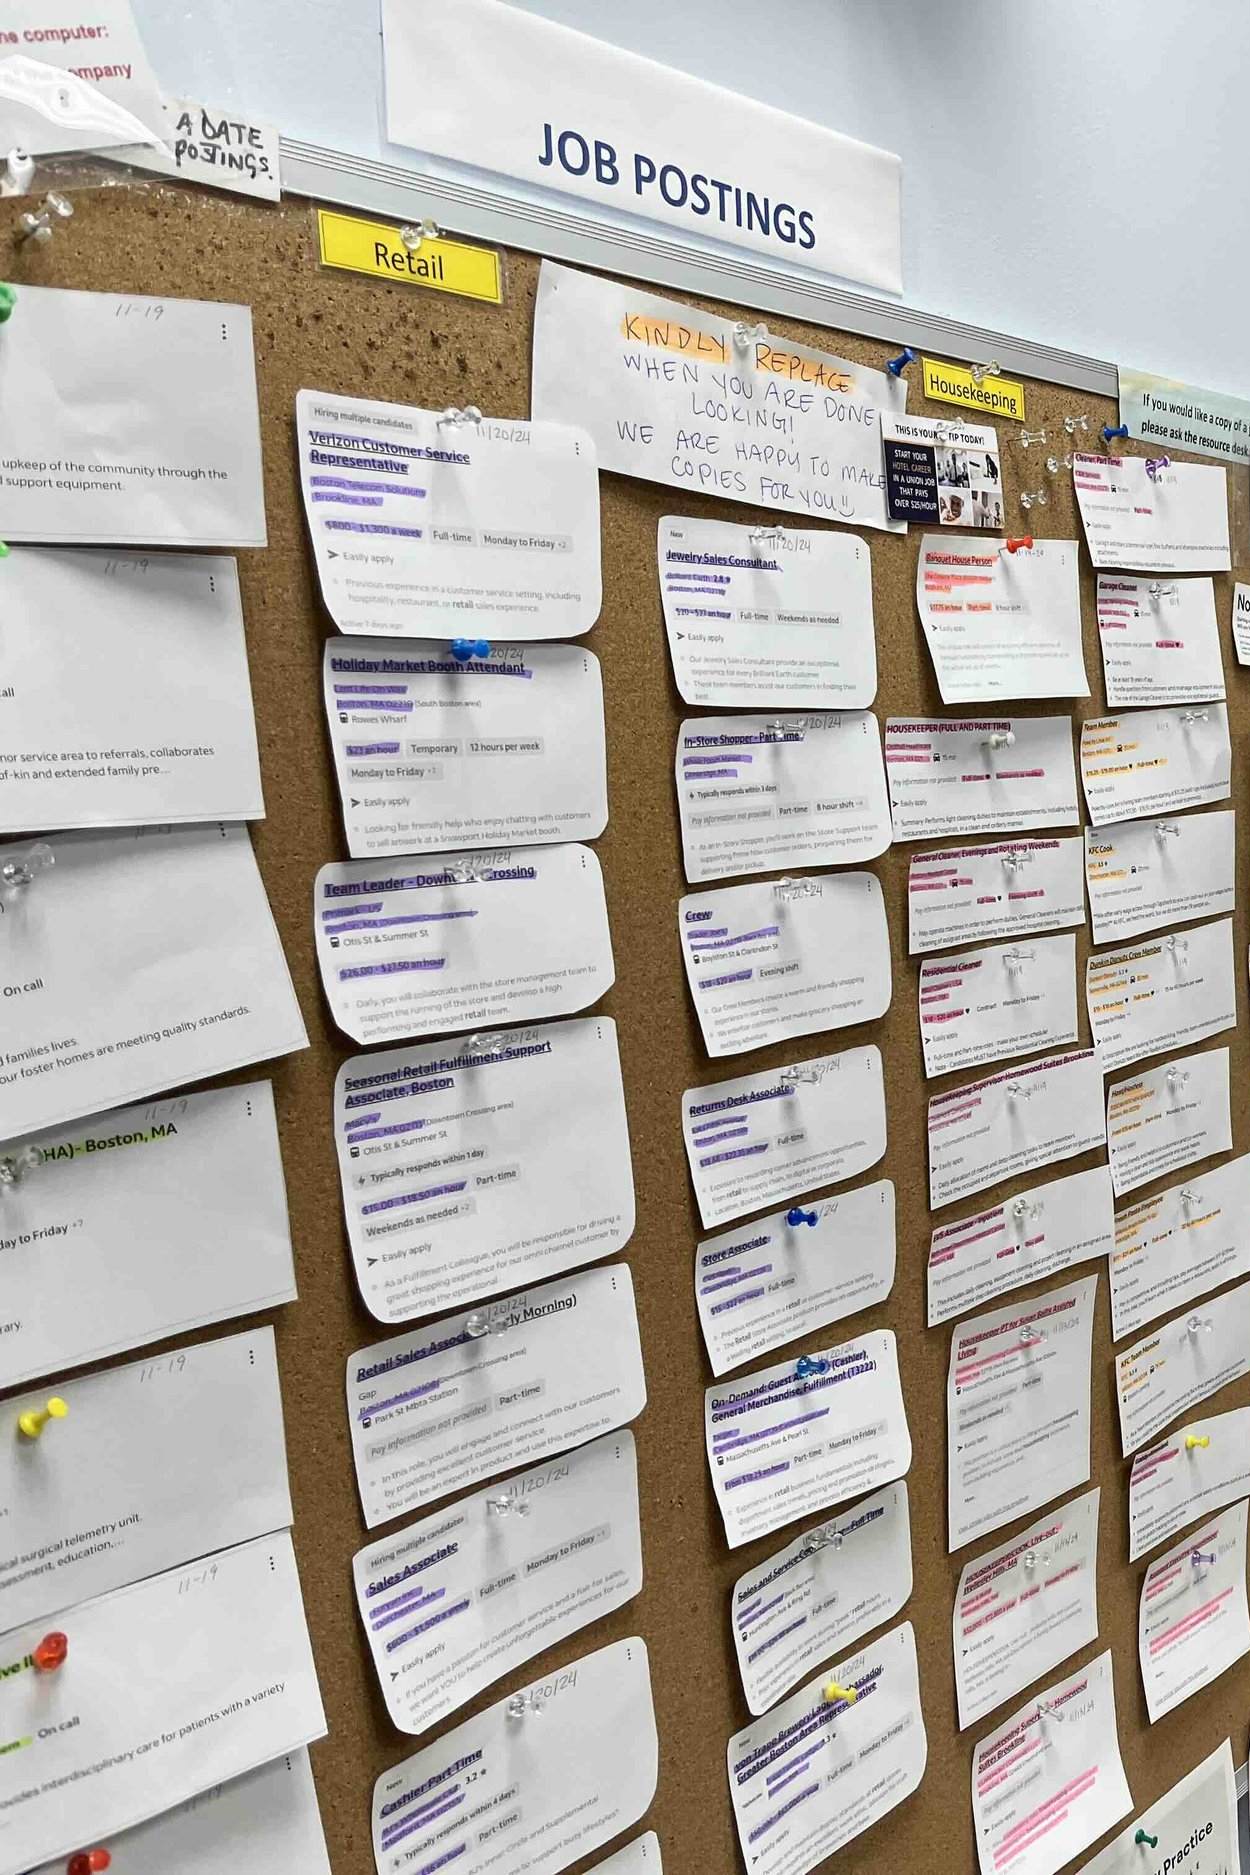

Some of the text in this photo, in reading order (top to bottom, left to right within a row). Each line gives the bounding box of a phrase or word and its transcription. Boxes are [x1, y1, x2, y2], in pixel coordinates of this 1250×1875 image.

[23, 23, 109, 45] computer:
[201, 108, 263, 149] DATE
[538, 123, 816, 250] JOB POSTINGS
[374, 242, 444, 281] Retail
[115, 303, 164, 321] 11-19
[624, 312, 851, 394] KINDLY REPLACE
[624, 353, 878, 426] WHEN YOU ARE DONE
[930, 373, 1017, 414] Housekeeping
[692, 393, 794, 445] LOOKING!
[1143, 393, 1150, 406] If
[1152, 398, 1167, 412] you
[1169, 402, 1192, 419] would
[1194, 407, 1207, 423] like
[1209, 413, 1214, 424] a
[1215, 415, 1232, 432] copy
[1234, 419, 1242, 432] of
[1243, 423, 1247, 434] a
[309, 430, 470, 464] Verizon Customer Service
[895, 424, 908, 434] THIS
[909, 426, 916, 436] IS
[918, 428, 938, 439] YOUR
[960, 433, 984, 446] TODAY!
[1141, 420, 1167, 439] please
[1169, 428, 1182, 442] ask
[1184, 430, 1197, 445] the
[1199, 434, 1230, 454] resource
[3, 459, 227, 480] upkeep of the community through the
[310, 450, 409, 475] Representative
[617, 420, 886, 490] WE ARE HAPPY TO MAKE
[892, 462, 932, 474] HOTEL CAREER
[894, 450, 927, 462] START YOUR
[6, 477, 124, 491] support equipment.
[671, 455, 747, 492] COPIES
[760, 477, 795, 502] FOR
[893, 474, 935, 486] IN A UNION JOB
[900, 487, 928, 498] THAT PAYS
[894, 500, 936, 510] OVER $25/HOUR
[666, 550, 777, 570] Jewelry Sales Consultant
[331, 658, 525, 674] Holiday Market Booth Attendant
[21, 746, 214, 763] service area to referrals, collaborates
[922, 960, 982, 978] Residential Cleaner
[5, 1037, 80, 1062] families lives.
[20, 1005, 250, 1078] foster homes are meeting quality standards.
[344, 1040, 552, 1092] Seasonal Retail Fulfillment Support
[344, 1075, 454, 1109] Associate, Boston
[689, 1083, 790, 1117] Returns Desk Associate
[86, 1122, 177, 1153] Boston, MA
[702, 1235, 768, 1266] Store Associate
[368, 1540, 458, 1597] Sales Associate
[1163, 1822, 1213, 1875] Practice
